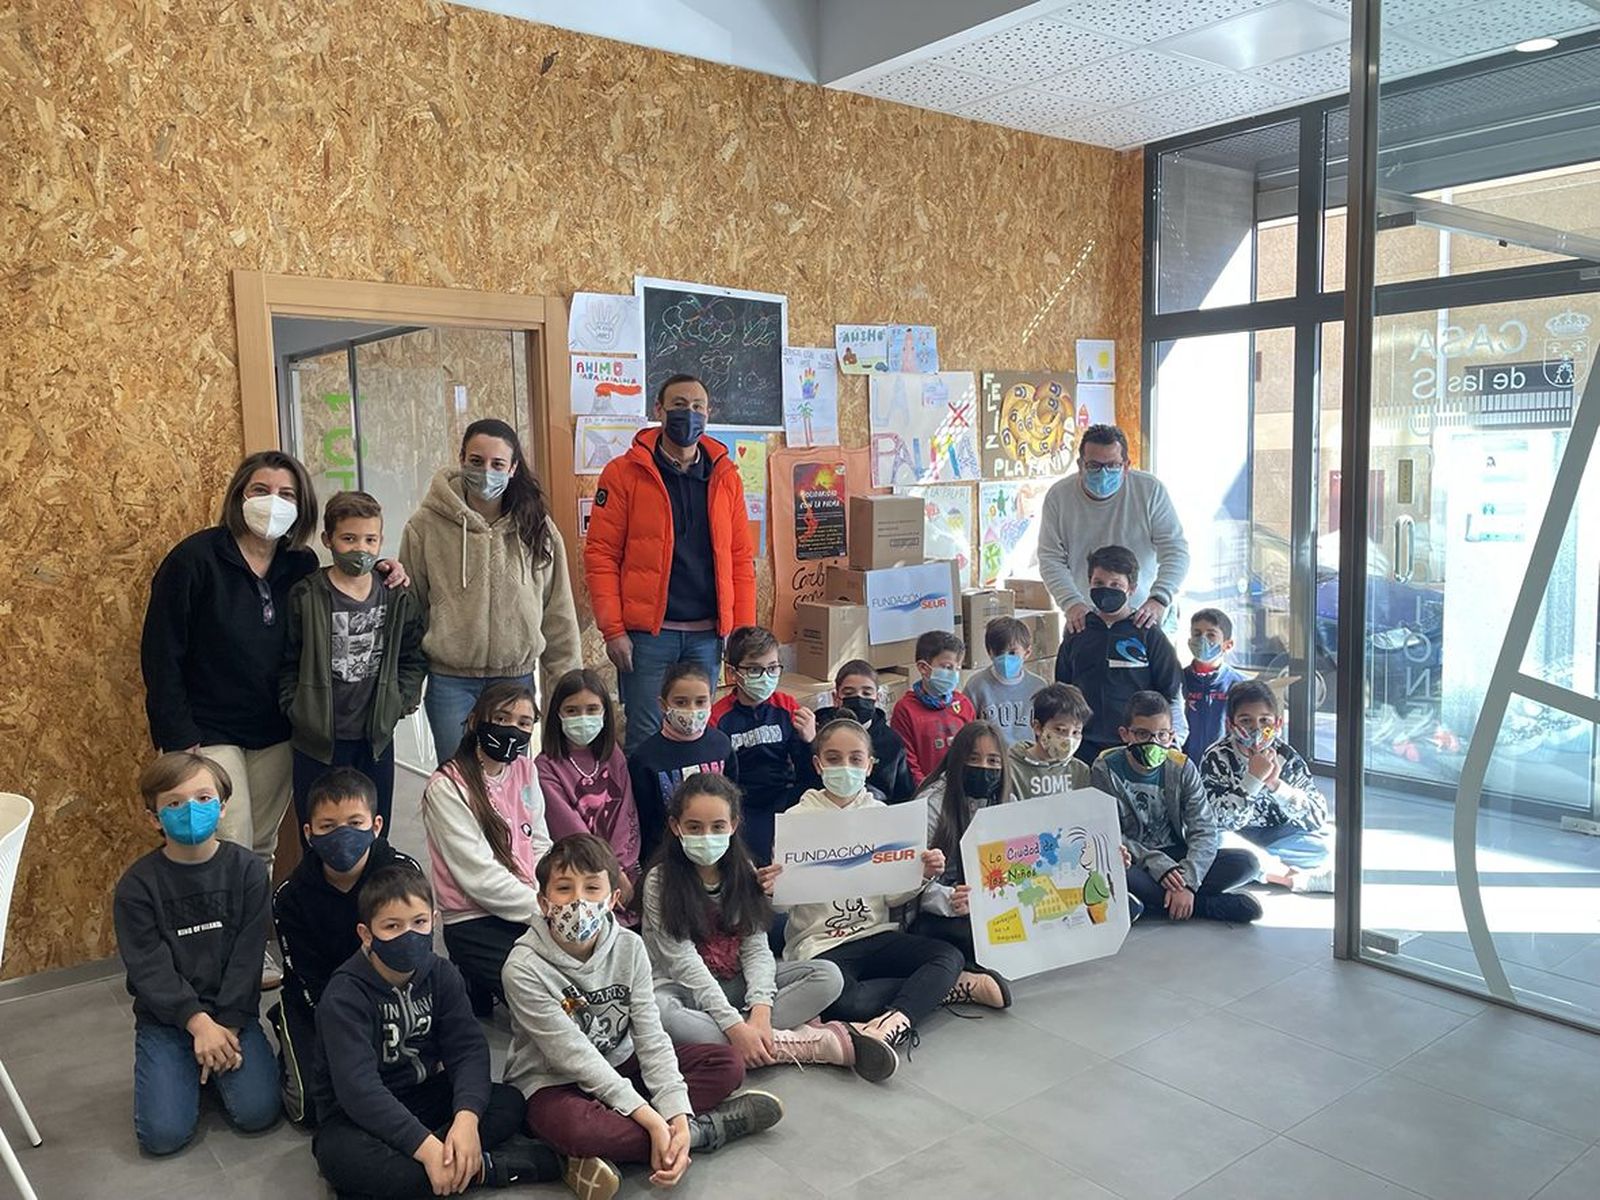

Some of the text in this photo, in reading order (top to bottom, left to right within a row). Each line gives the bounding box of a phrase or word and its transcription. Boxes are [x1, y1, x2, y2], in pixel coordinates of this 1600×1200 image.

[791, 561, 825, 591] Carb
[1030, 774, 1073, 795] SOME
[871, 848, 915, 864] SEUR
